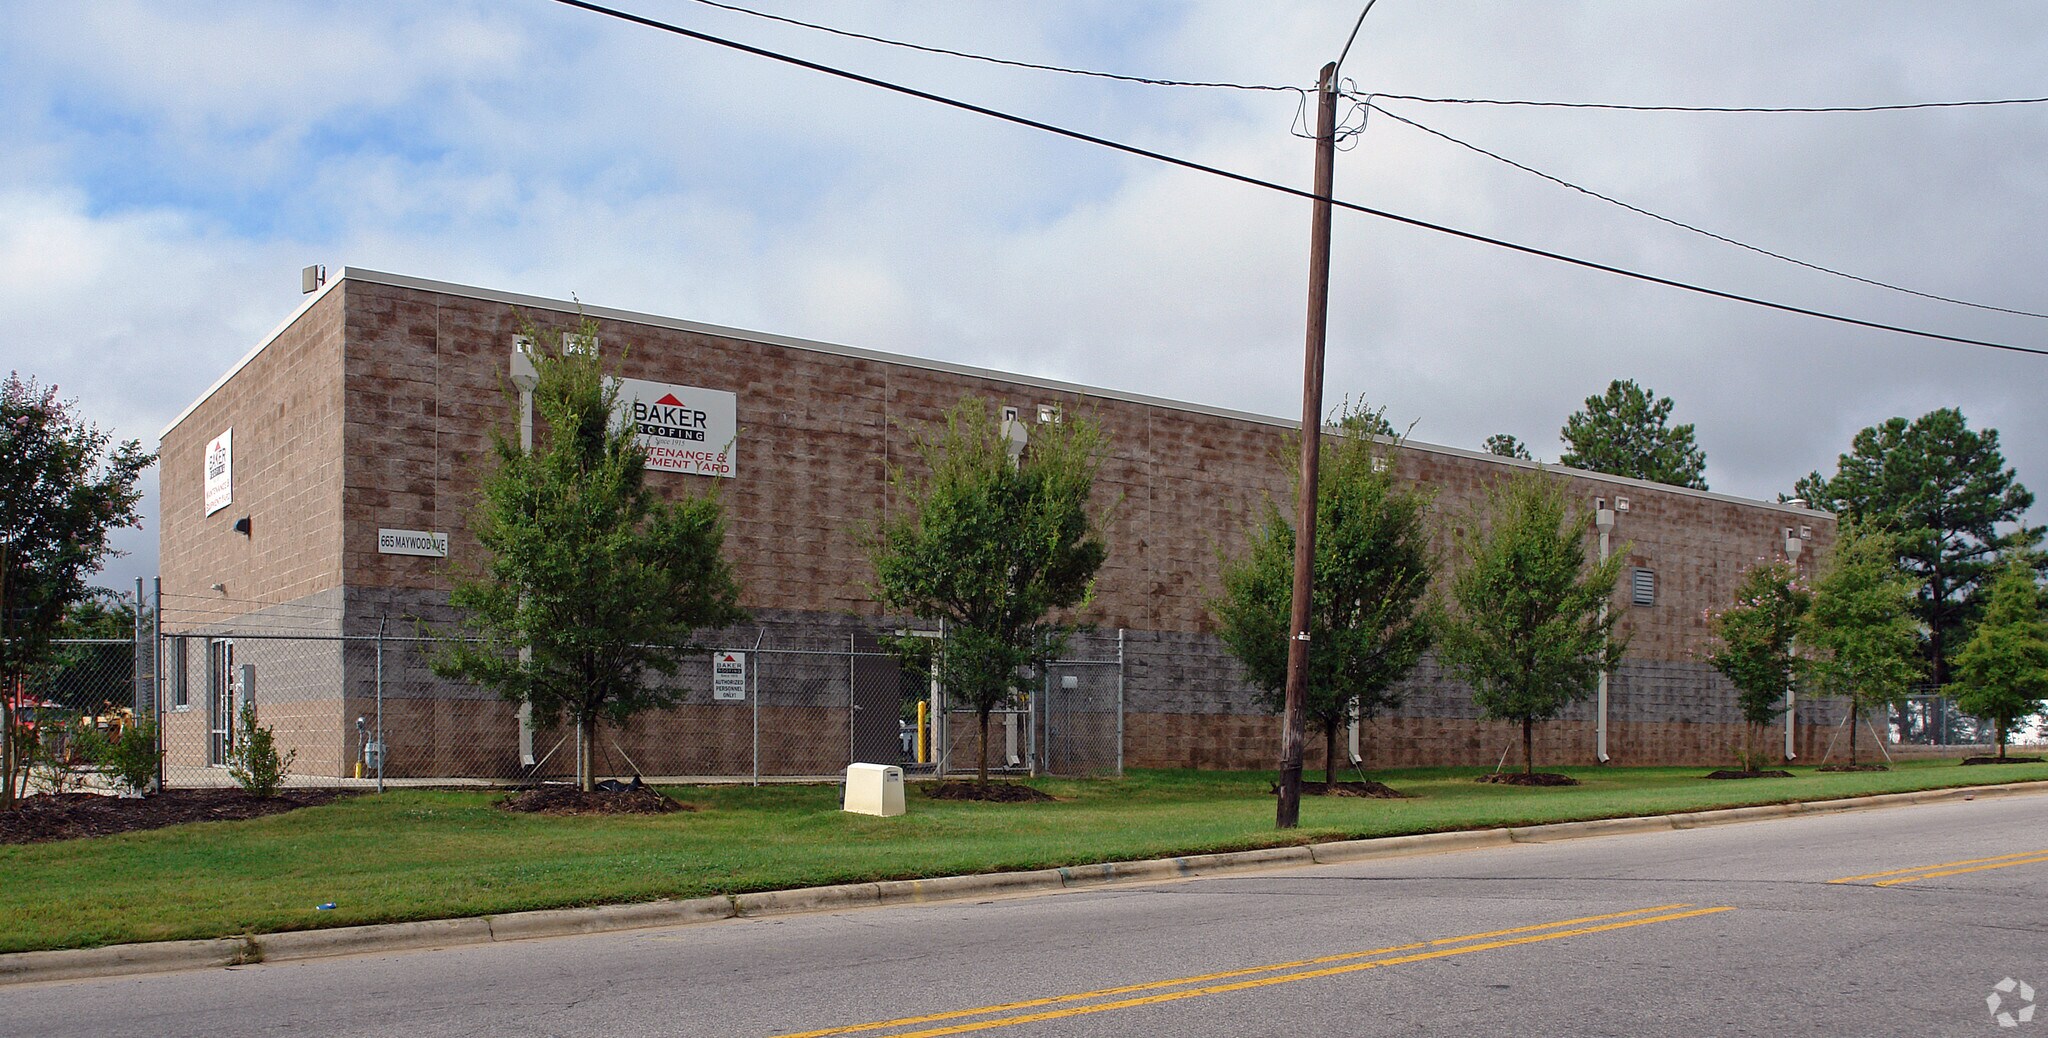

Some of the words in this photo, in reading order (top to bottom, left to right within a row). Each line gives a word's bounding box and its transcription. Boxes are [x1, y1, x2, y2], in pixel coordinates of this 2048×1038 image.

[635, 403, 707, 429] BAKER
[637, 425, 704, 441] ROOFING
[717, 452, 728, 463] &
[695, 460, 730, 473] YARD
[381, 535, 394, 547] 665
[395, 536, 431, 550] MAYWOOD
[431, 539, 446, 551] AVE
